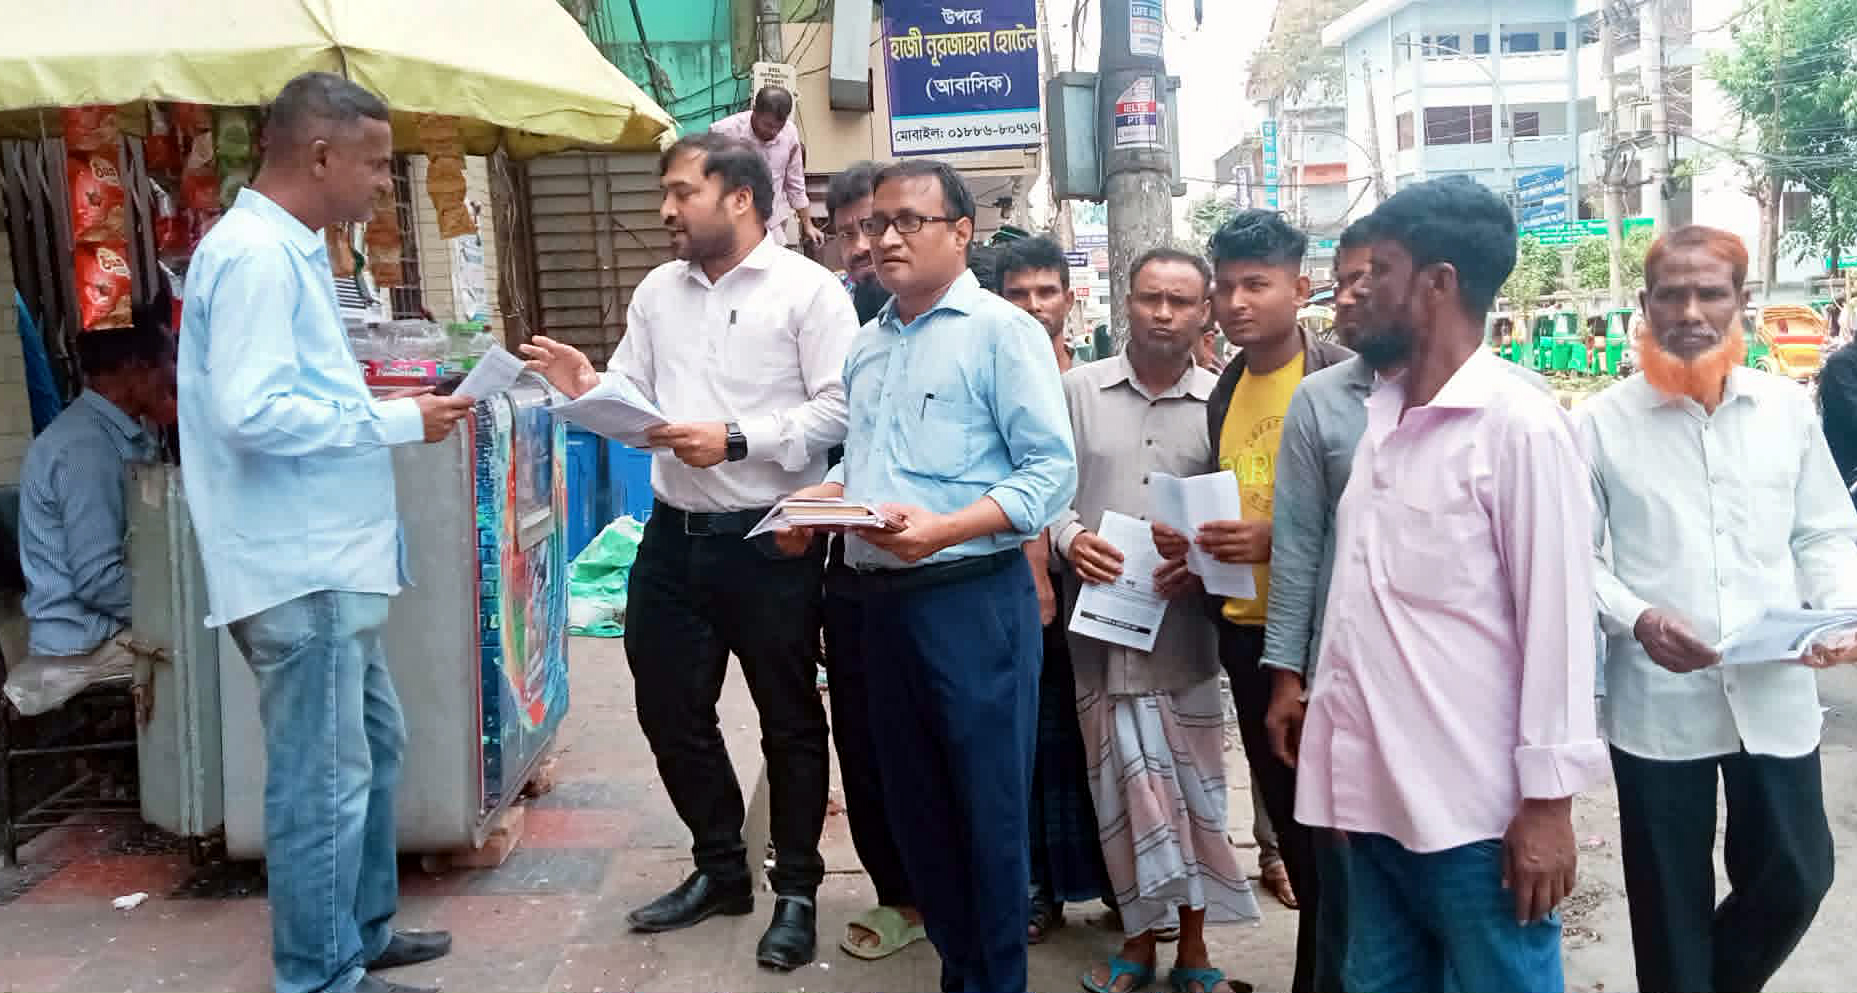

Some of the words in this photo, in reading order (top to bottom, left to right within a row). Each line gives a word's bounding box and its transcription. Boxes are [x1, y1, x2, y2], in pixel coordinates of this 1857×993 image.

[941, 8, 983, 25] উপরে
[889, 26, 923, 61] হাজী
[924, 31, 991, 67] নূরজাহান
[993, 23, 1037, 54] হোটেল
[926, 71, 1012, 101] (আবাসিক)
[948, 120, 1041, 140] ০১৮৮৬-৮০৭১৭
